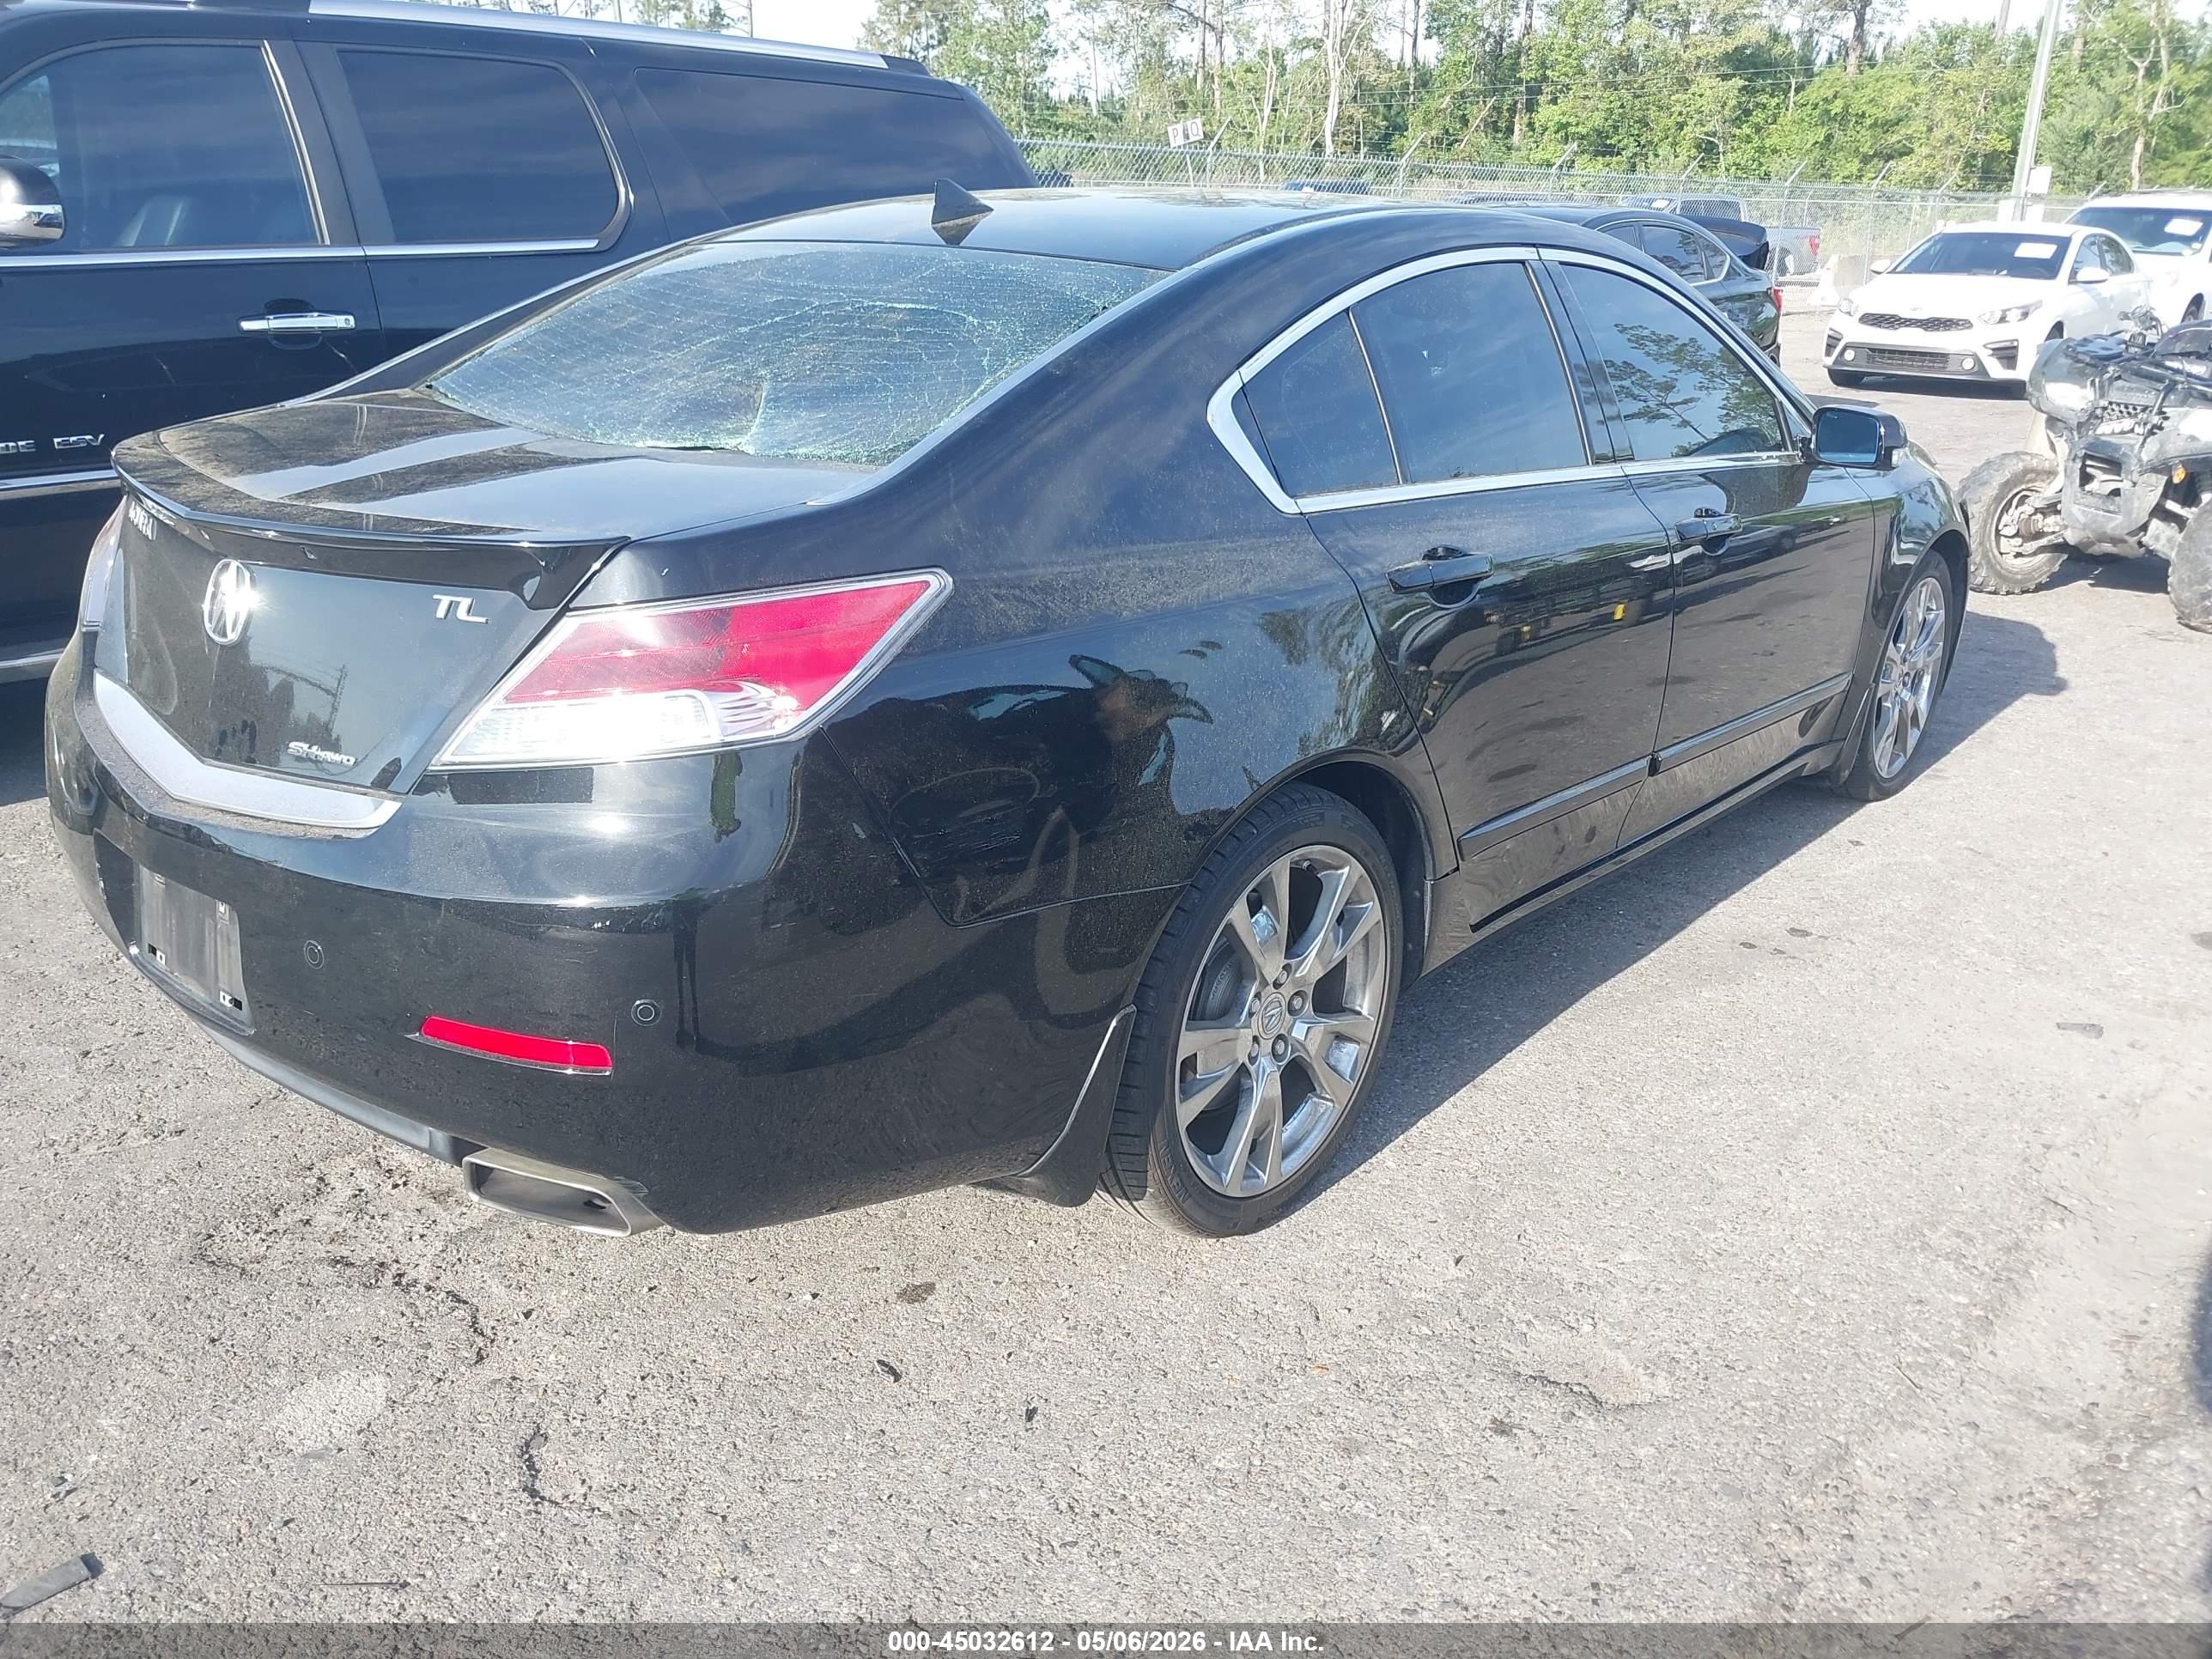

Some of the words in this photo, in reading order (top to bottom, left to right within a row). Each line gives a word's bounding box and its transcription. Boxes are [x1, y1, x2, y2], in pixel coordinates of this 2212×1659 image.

[1172, 128, 1179, 144] P
[1190, 121, 1201, 137] Q
[52, 434, 105, 449] ESV
[432, 594, 492, 624] TL
